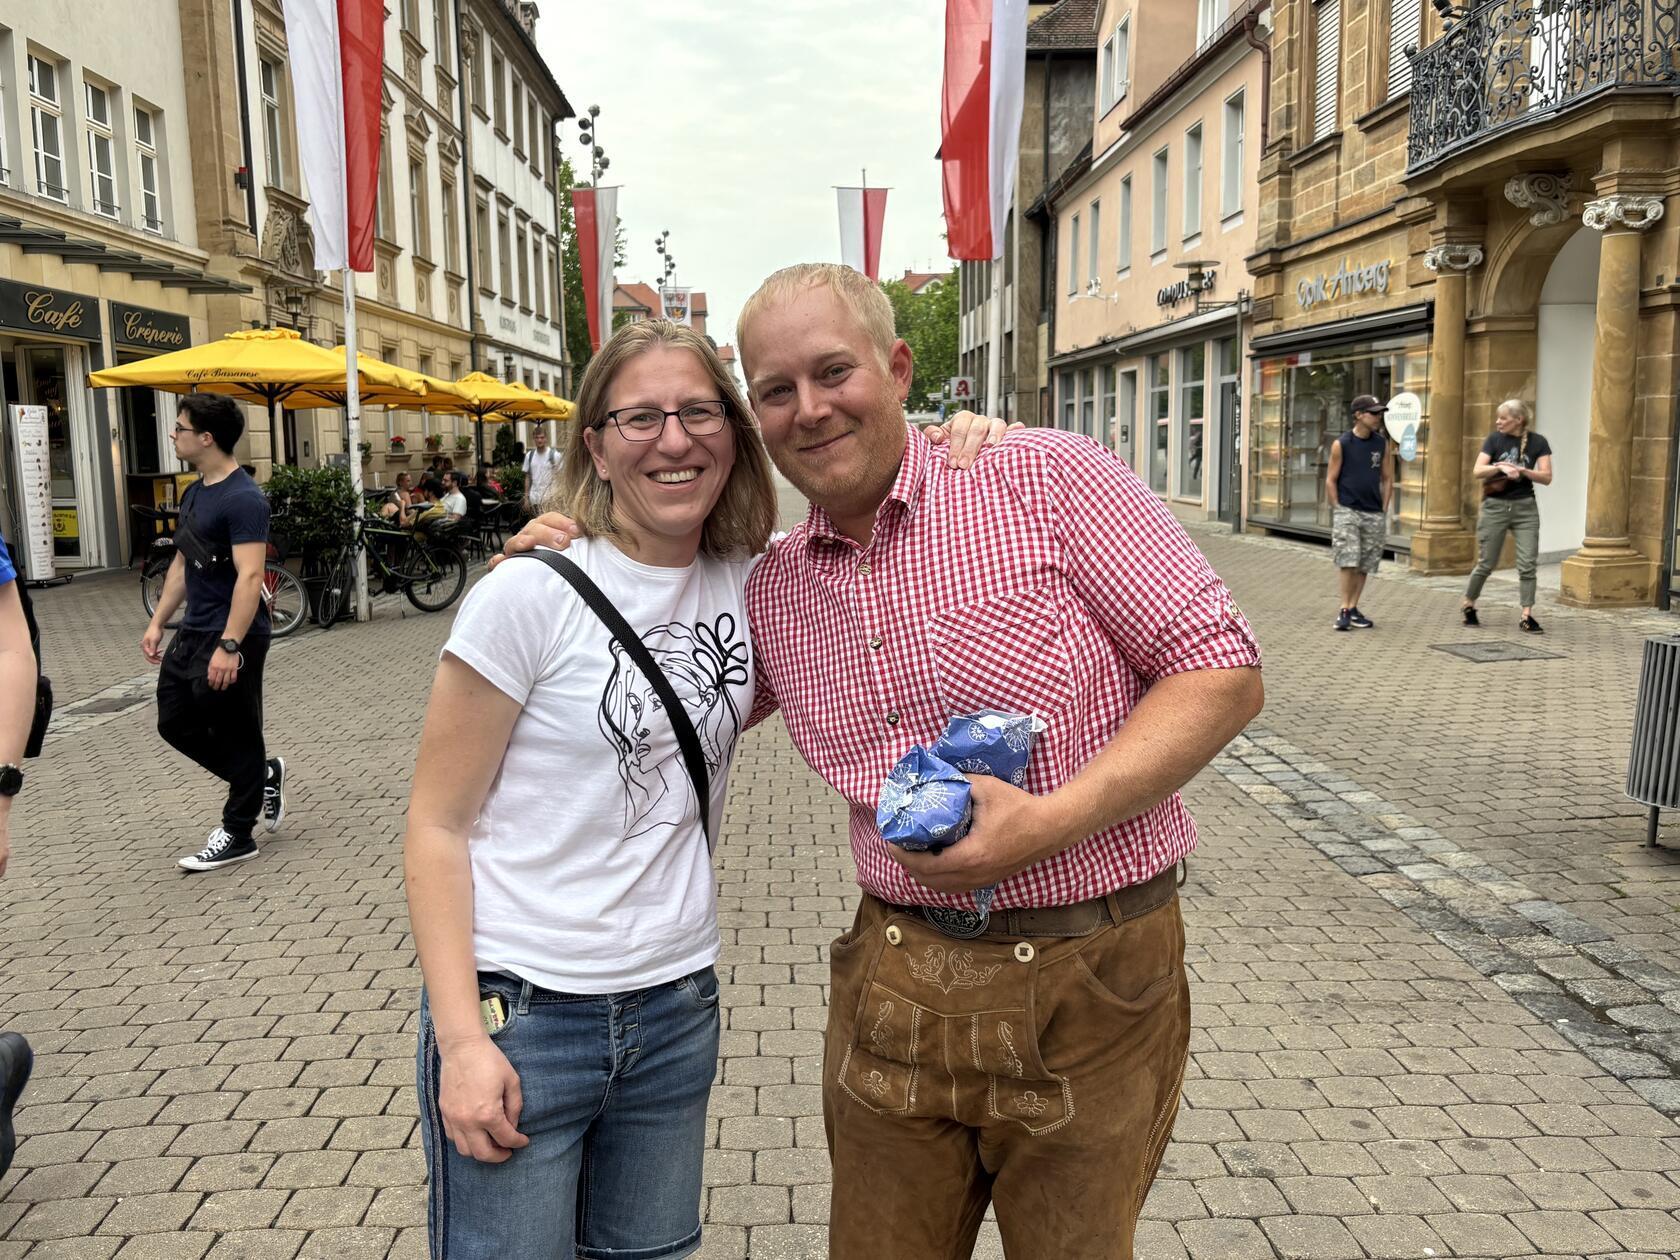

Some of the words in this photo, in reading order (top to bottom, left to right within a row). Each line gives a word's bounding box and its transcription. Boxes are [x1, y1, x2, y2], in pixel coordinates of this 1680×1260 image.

[1297, 276, 1327, 309] Optik
[1328, 257, 1391, 299] Amberg
[25, 291, 83, 330] Café
[124, 311, 184, 345] Crêperie
[185, 369, 208, 381] Café
